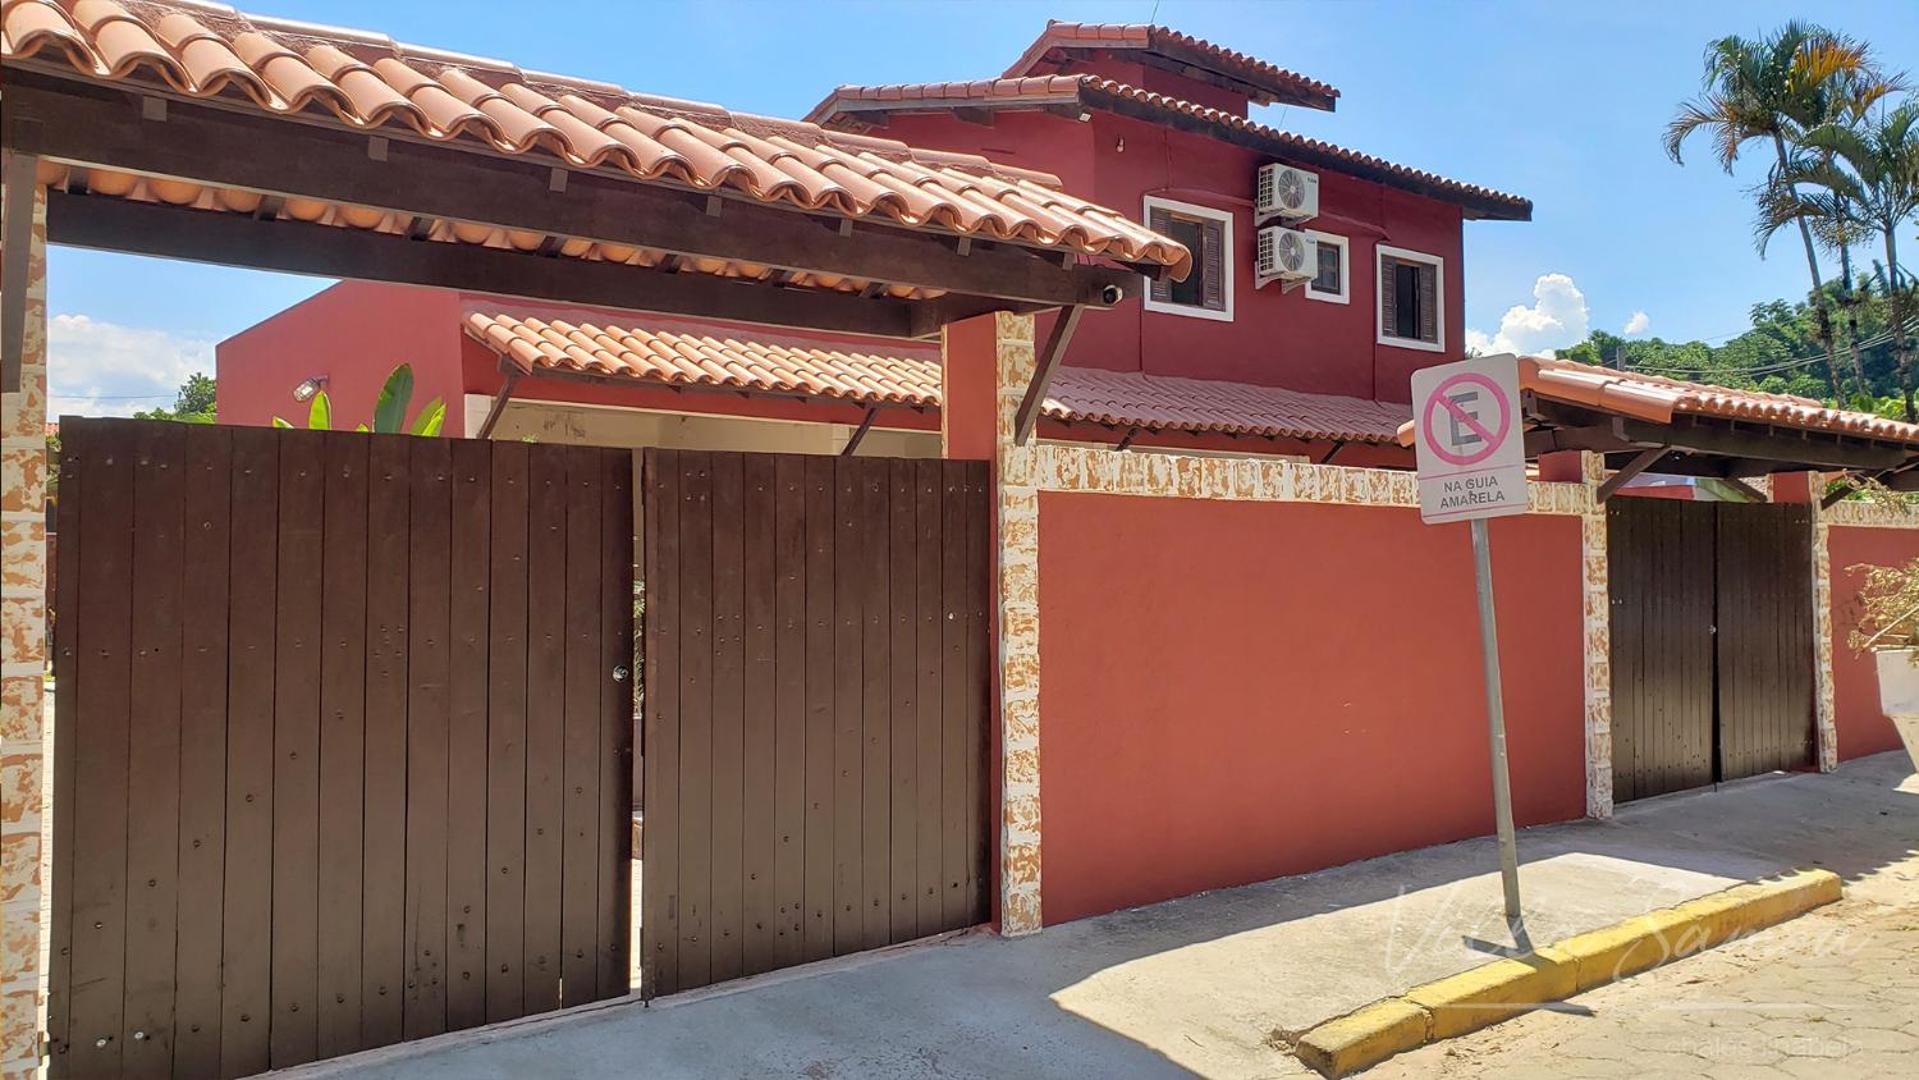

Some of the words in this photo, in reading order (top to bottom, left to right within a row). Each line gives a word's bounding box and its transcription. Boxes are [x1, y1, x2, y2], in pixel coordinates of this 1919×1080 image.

[1448, 391, 1482, 446] E
[1444, 480, 1462, 493] NA
[1465, 475, 1499, 490] GUIA
[1440, 490, 1505, 509] AMARELA
